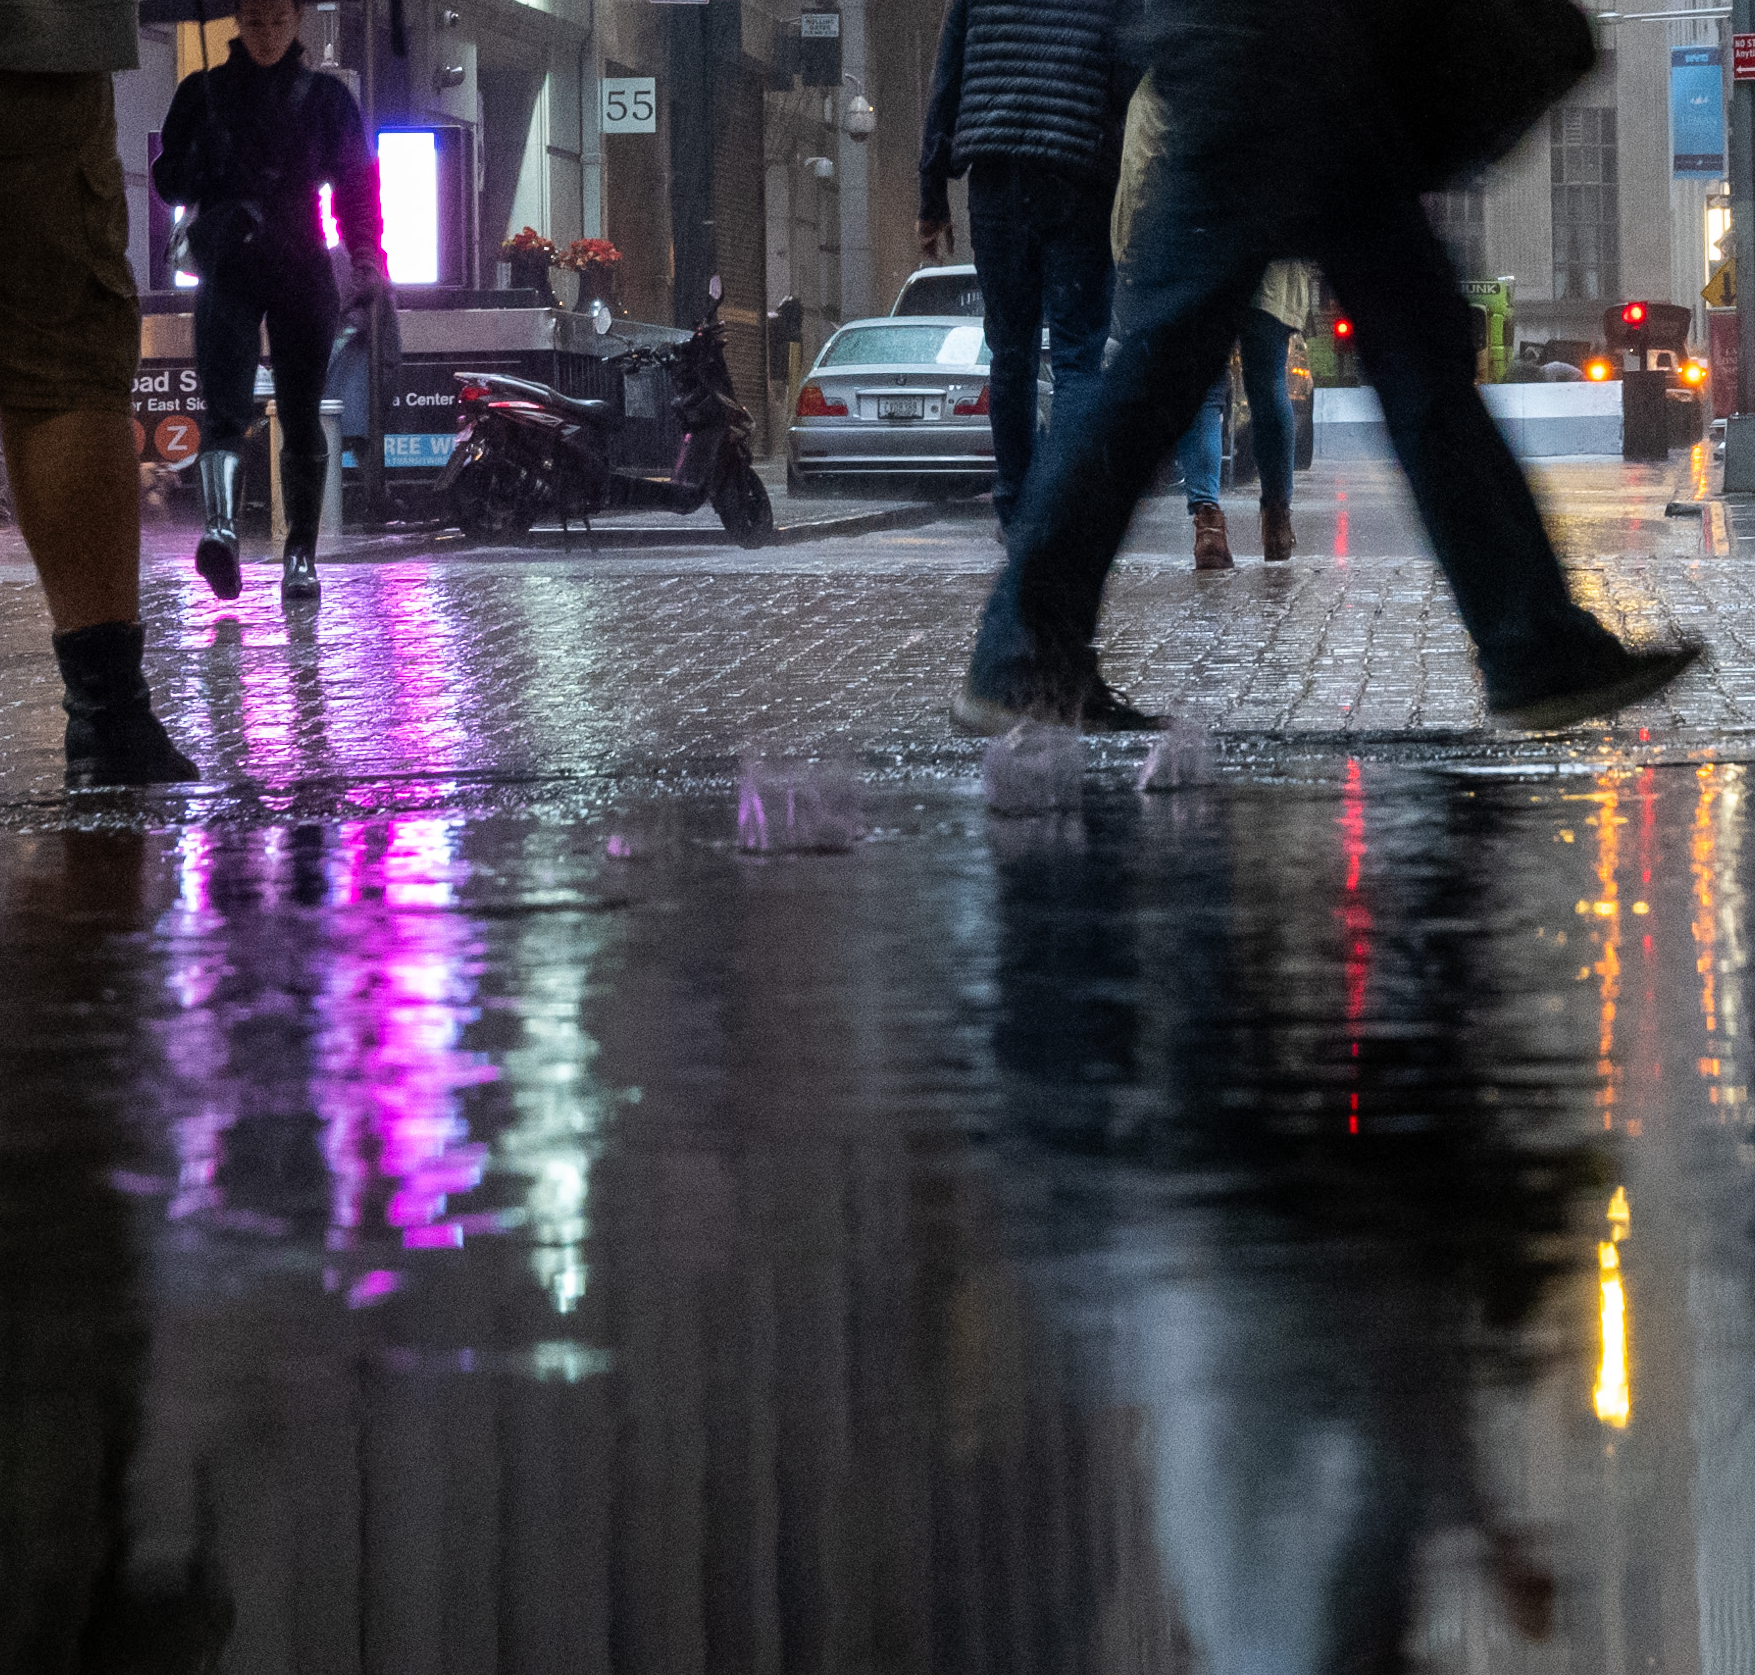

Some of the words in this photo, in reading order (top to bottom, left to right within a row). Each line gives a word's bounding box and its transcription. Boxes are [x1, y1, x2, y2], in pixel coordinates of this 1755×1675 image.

[1735, 39, 1745, 48] NO
[606, 90, 653, 121] 55
[180, 370, 197, 392] S
[148, 398, 180, 411] East
[406, 392, 455, 406] Center
[167, 425, 188, 451] Z
[384, 437, 421, 455] REE
